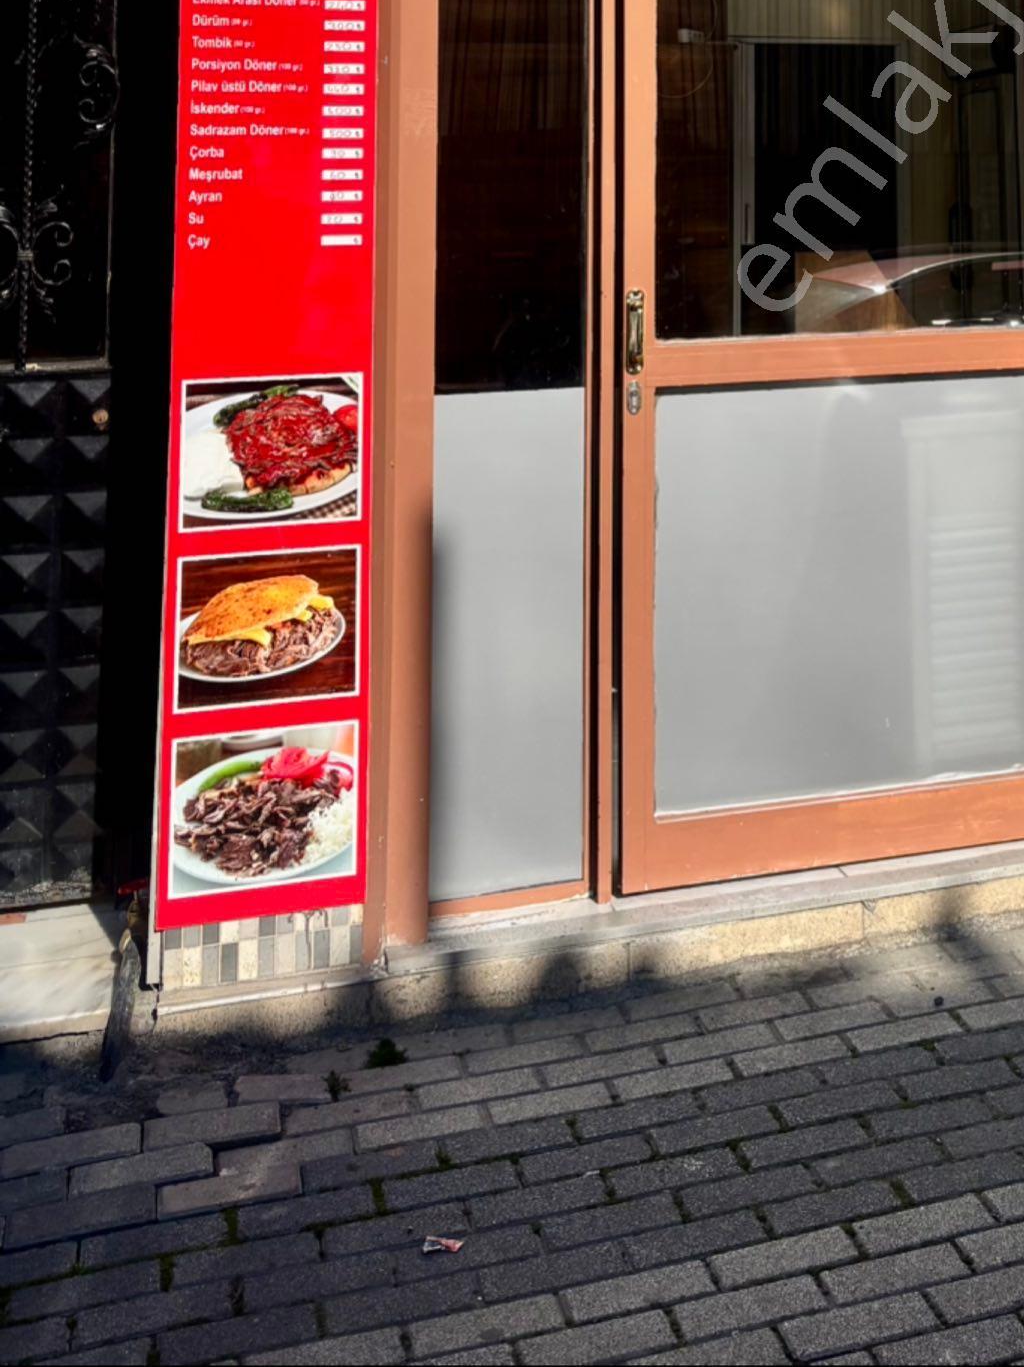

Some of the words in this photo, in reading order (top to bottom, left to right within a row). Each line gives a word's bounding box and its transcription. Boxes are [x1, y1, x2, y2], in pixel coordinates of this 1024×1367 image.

[192, 14, 230, 26] Dürüm
[192, 36, 232, 48] Tombik
[192, 58, 241, 73] Porsiyon
[244, 59, 277, 71] Döner
[191, 80, 218, 92] Pilav
[221, 81, 246, 92] üstü
[249, 80, 282, 92] Döner
[191, 100, 239, 114] İskender
[190, 124, 246, 136] Sadrazam
[250, 124, 284, 135] Döner
[190, 146, 224, 160] Çorba
[189, 168, 242, 182] Meşrubat
[189, 191, 222, 204] Ayran
[189, 212, 204, 224] Su
[188, 234, 210, 249] Çay
